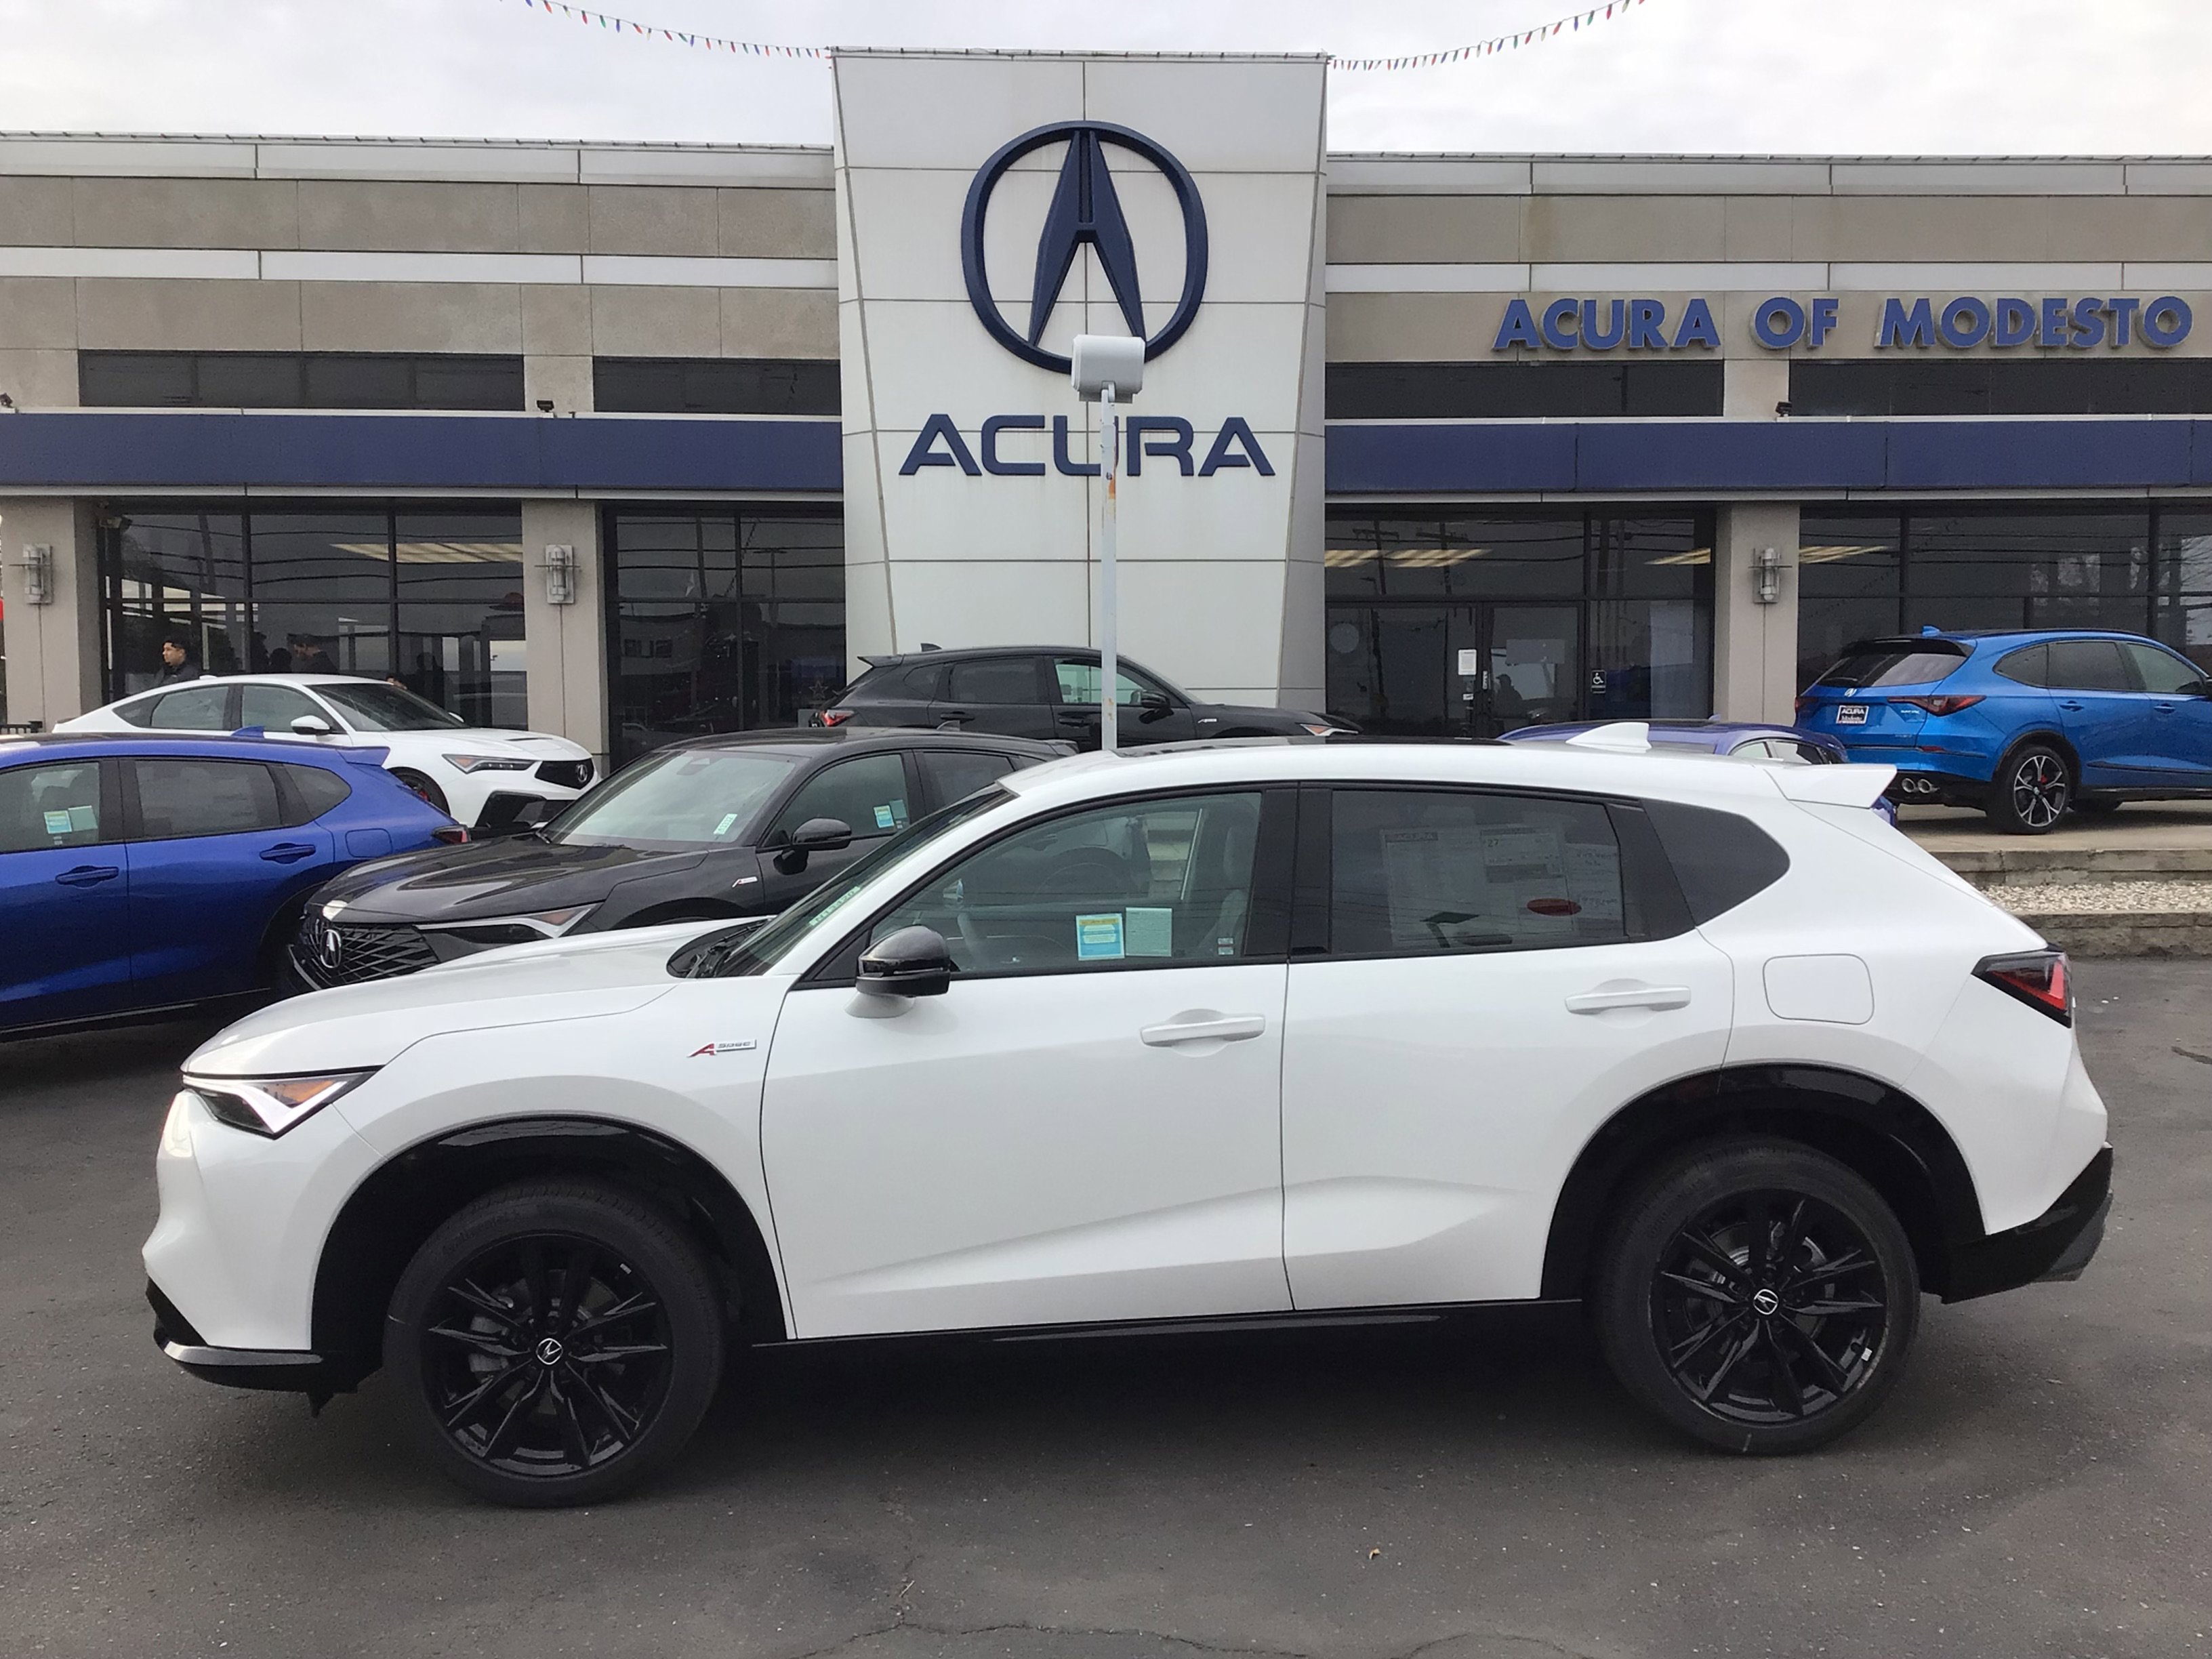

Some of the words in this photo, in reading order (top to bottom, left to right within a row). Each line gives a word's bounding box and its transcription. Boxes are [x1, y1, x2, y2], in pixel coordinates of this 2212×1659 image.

[1492, 298, 1721, 350] ACURA
[1751, 296, 1839, 349] OF
[1874, 295, 2194, 349] MODESTO
[899, 413, 1275, 476] ACURA
